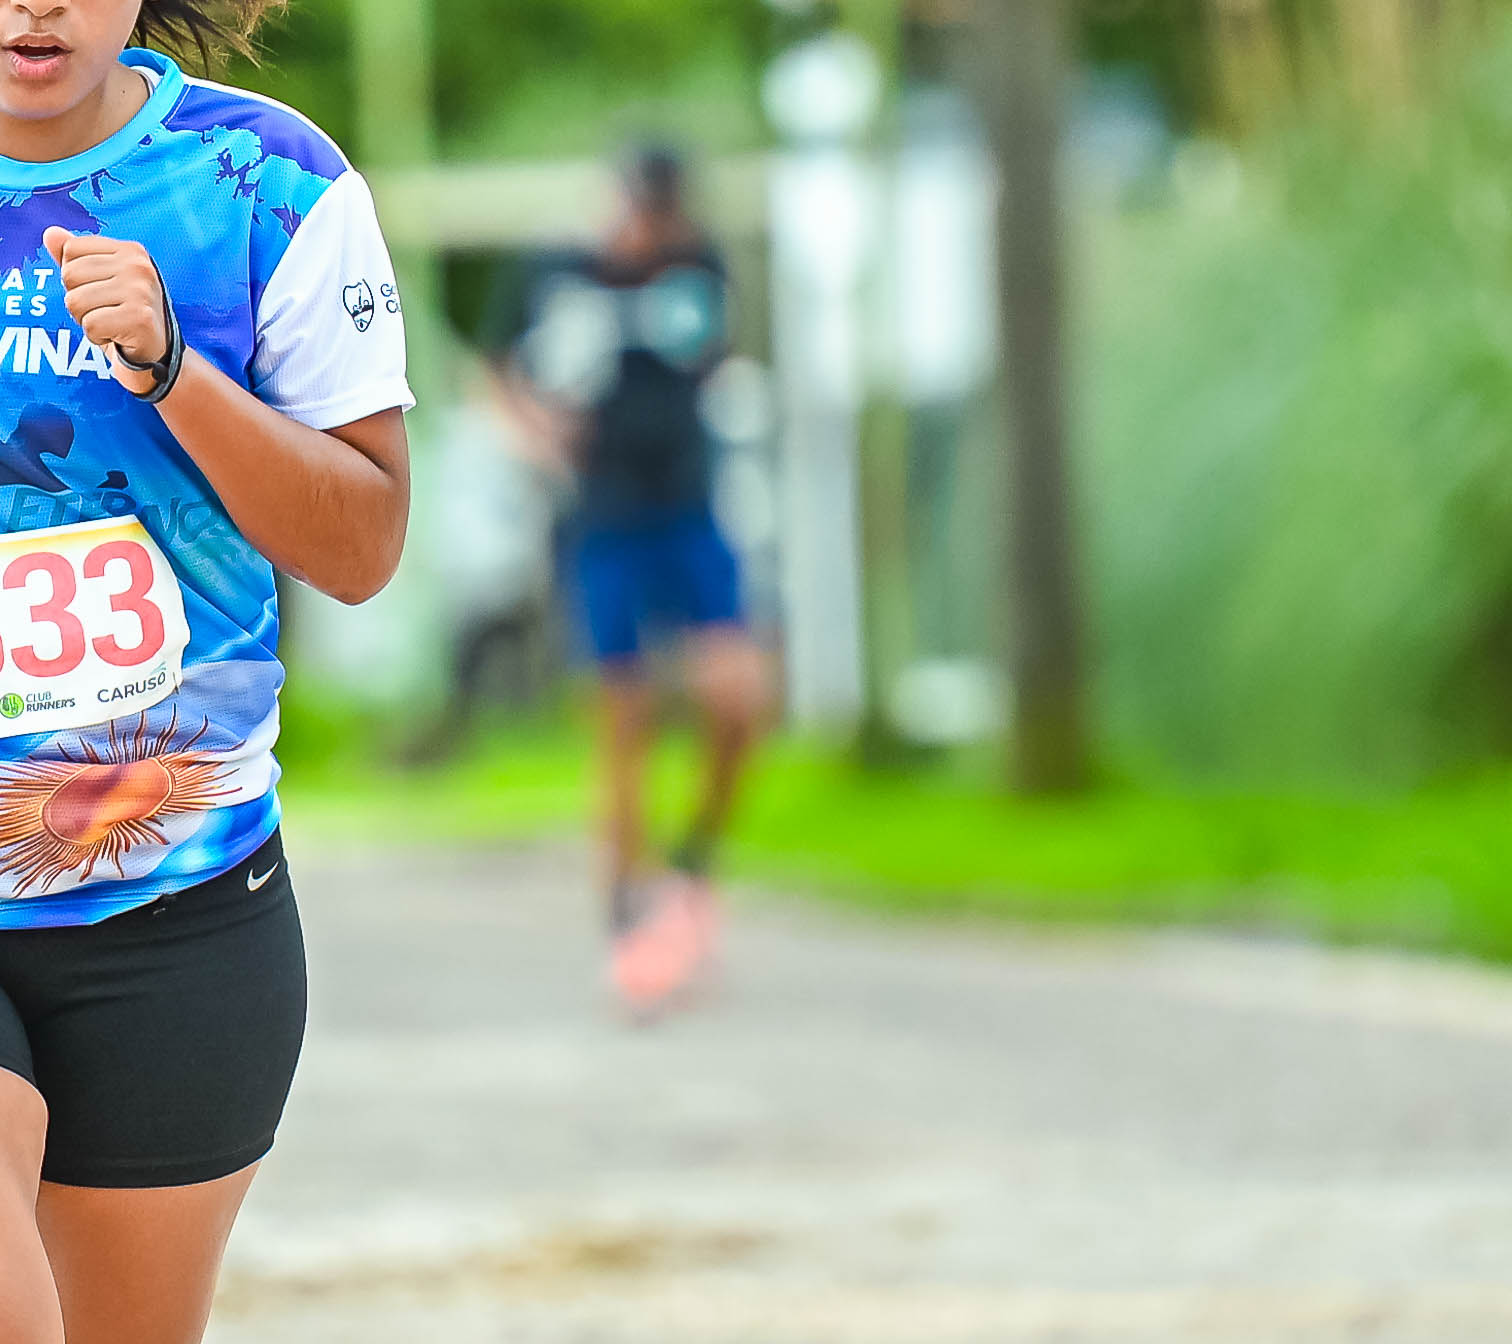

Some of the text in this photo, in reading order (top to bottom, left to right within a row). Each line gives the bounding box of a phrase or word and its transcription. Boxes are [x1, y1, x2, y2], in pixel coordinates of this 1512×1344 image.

[96, 671, 166, 703] CARUSO
[25, 691, 52, 703] CLUB
[26, 697, 76, 712] RUNNER'S
